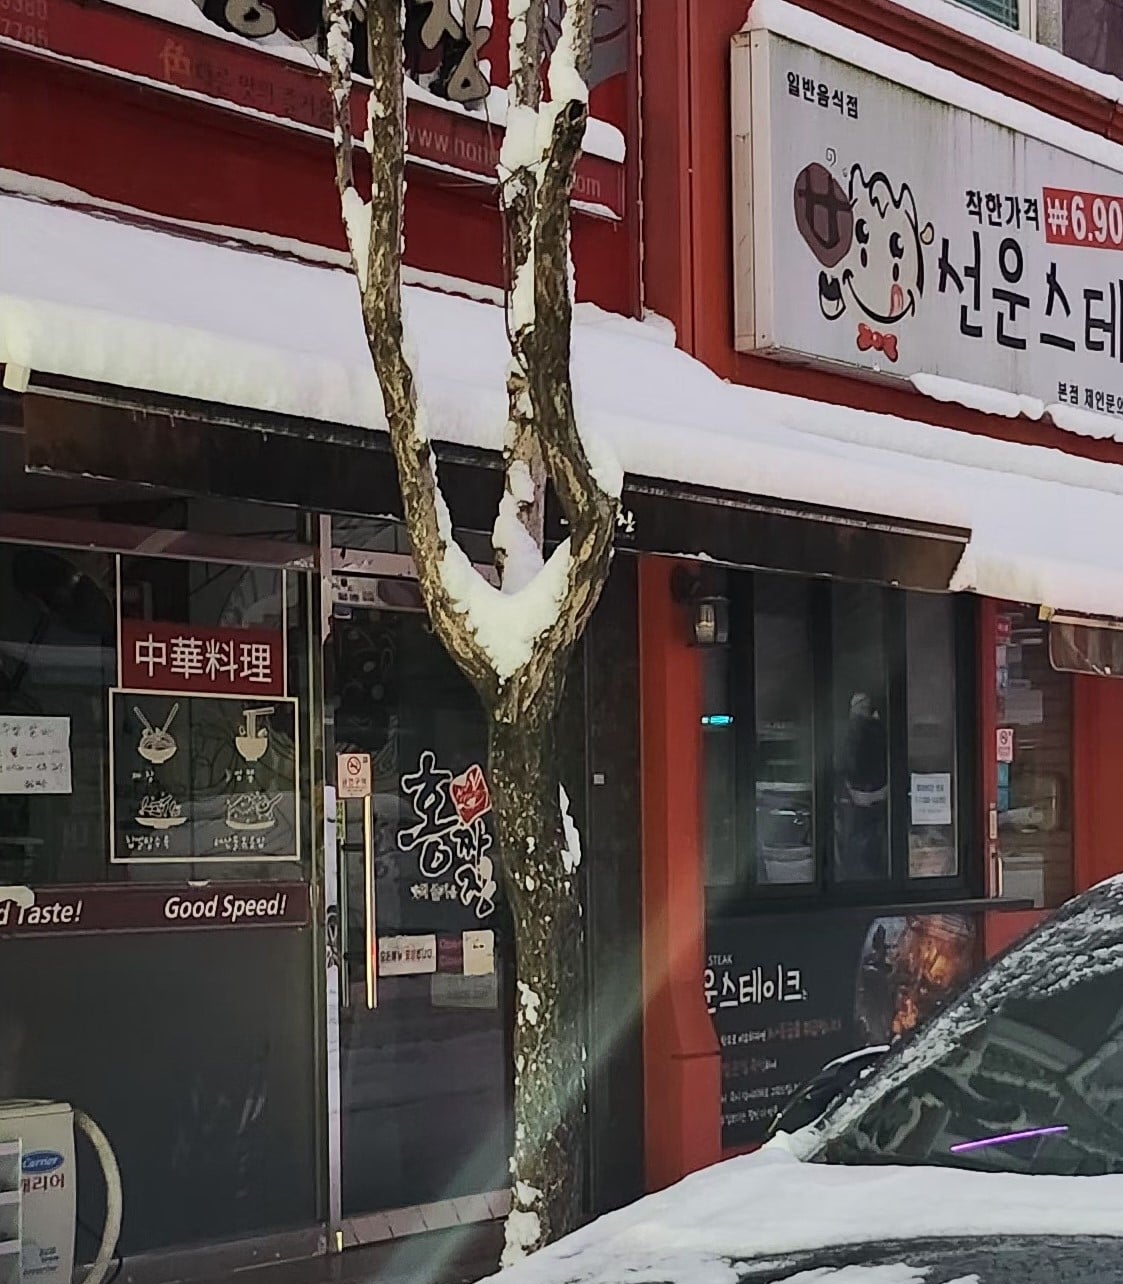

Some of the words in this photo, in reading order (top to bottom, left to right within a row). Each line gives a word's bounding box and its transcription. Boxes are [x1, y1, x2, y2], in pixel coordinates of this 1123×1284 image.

[786, 71, 859, 120] 일반음식점
[965, 190, 1040, 231] 착한가격
[1057, 381, 1079, 405] 본점
[135, 633, 272, 683] 中華料理
[164, 894, 218, 919] Good
[221, 893, 287, 922] Speed!
[708, 954, 733, 966] STEAK
